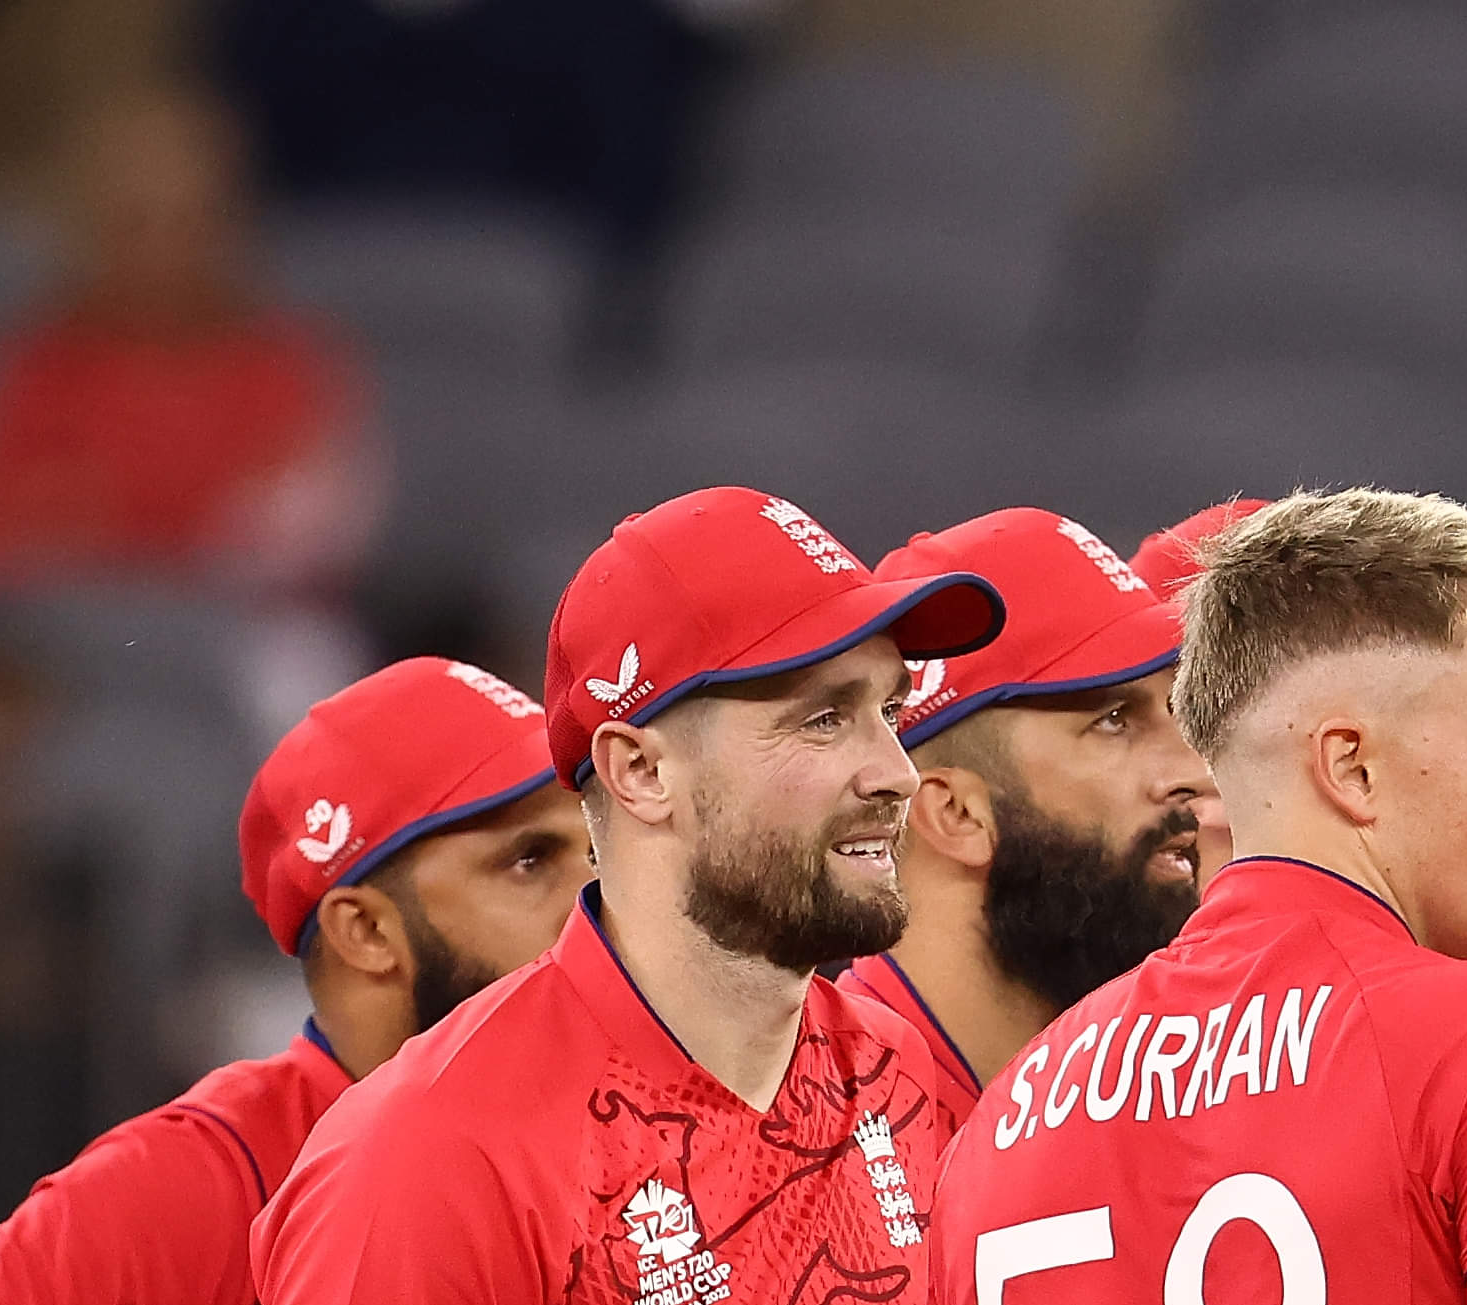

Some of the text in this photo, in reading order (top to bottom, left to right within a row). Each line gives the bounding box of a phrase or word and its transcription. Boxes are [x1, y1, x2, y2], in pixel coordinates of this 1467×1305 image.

[608, 680, 654, 718] CASTORE
[994, 984, 1334, 1152] S.CURRAN
[637, 1255, 658, 1274] ICC
[639, 1250, 715, 1296] MEN'S T20
[692, 1263, 732, 1294] CUP
[702, 1284, 731, 1305] 2022
